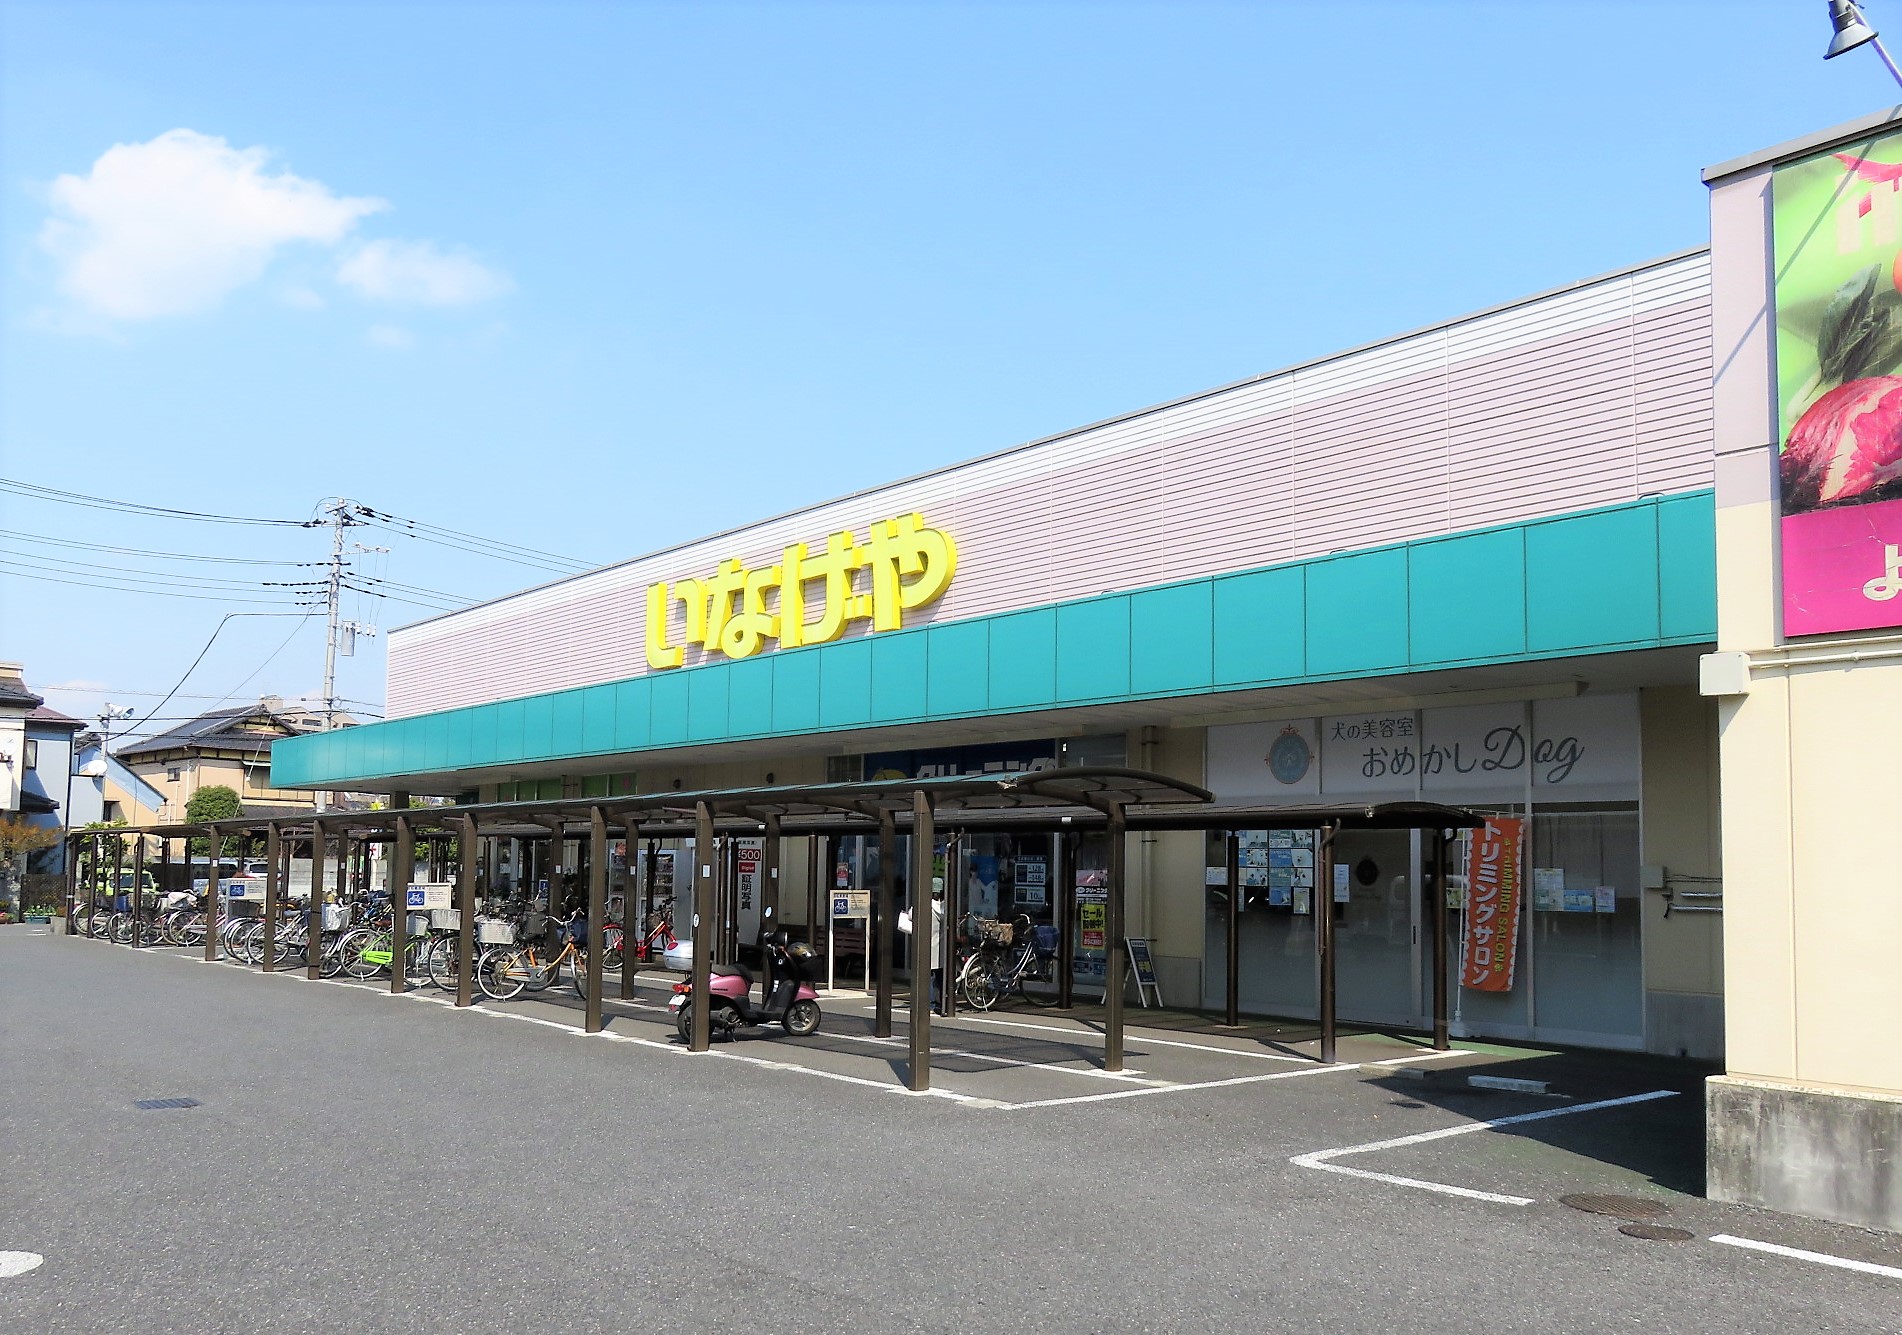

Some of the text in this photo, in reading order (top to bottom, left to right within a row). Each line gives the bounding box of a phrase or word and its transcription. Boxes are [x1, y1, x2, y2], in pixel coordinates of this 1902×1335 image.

[646, 512, 957, 668] いなげや
[1331, 717, 1414, 741] 犬の美容室
[741, 874, 752, 910] 証明写真
[1082, 908, 1103, 918] セール
[1472, 821, 1502, 985] トリミングサロン
[1495, 850, 1513, 963] TRIMMING SALON
